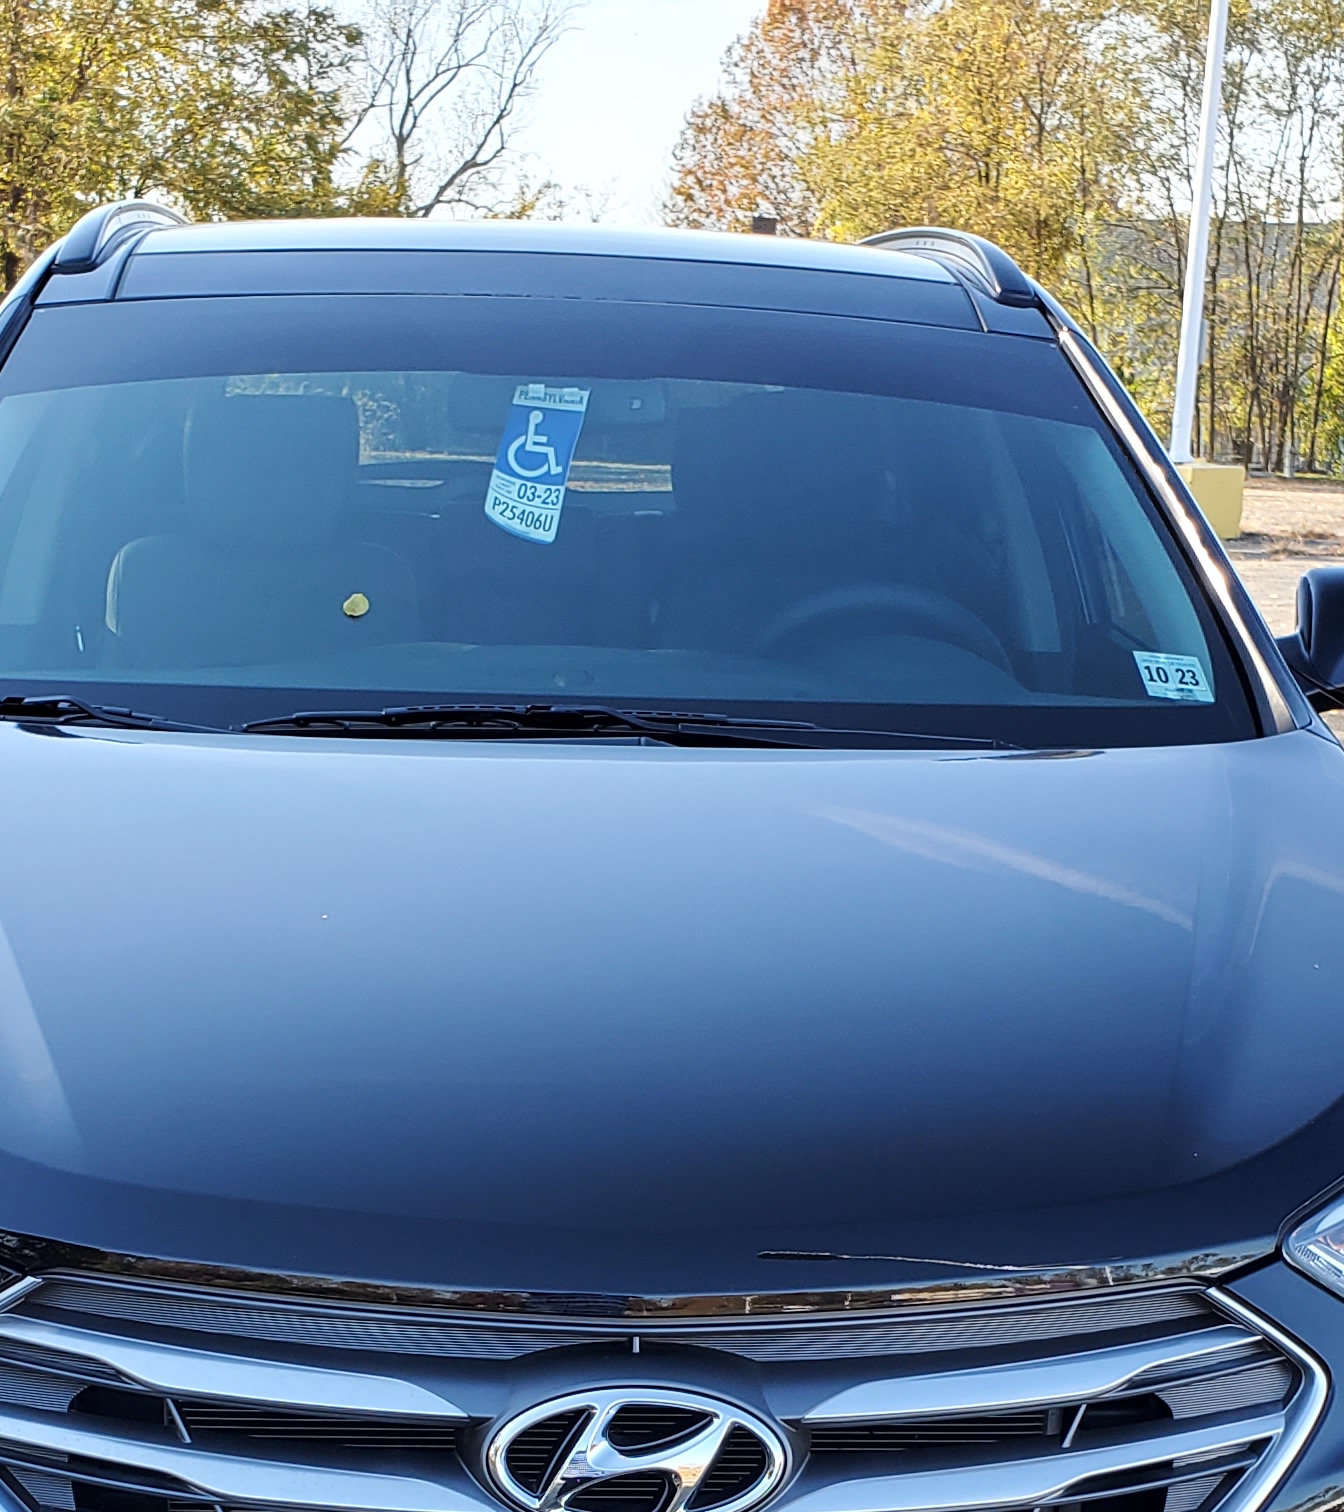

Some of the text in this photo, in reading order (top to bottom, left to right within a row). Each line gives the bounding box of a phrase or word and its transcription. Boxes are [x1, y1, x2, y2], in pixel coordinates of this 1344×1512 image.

[518, 390, 585, 405] PESYLVA
[517, 483, 561, 506] 03-23
[492, 496, 554, 532] P25406U
[1144, 665, 1200, 686] 10 23
